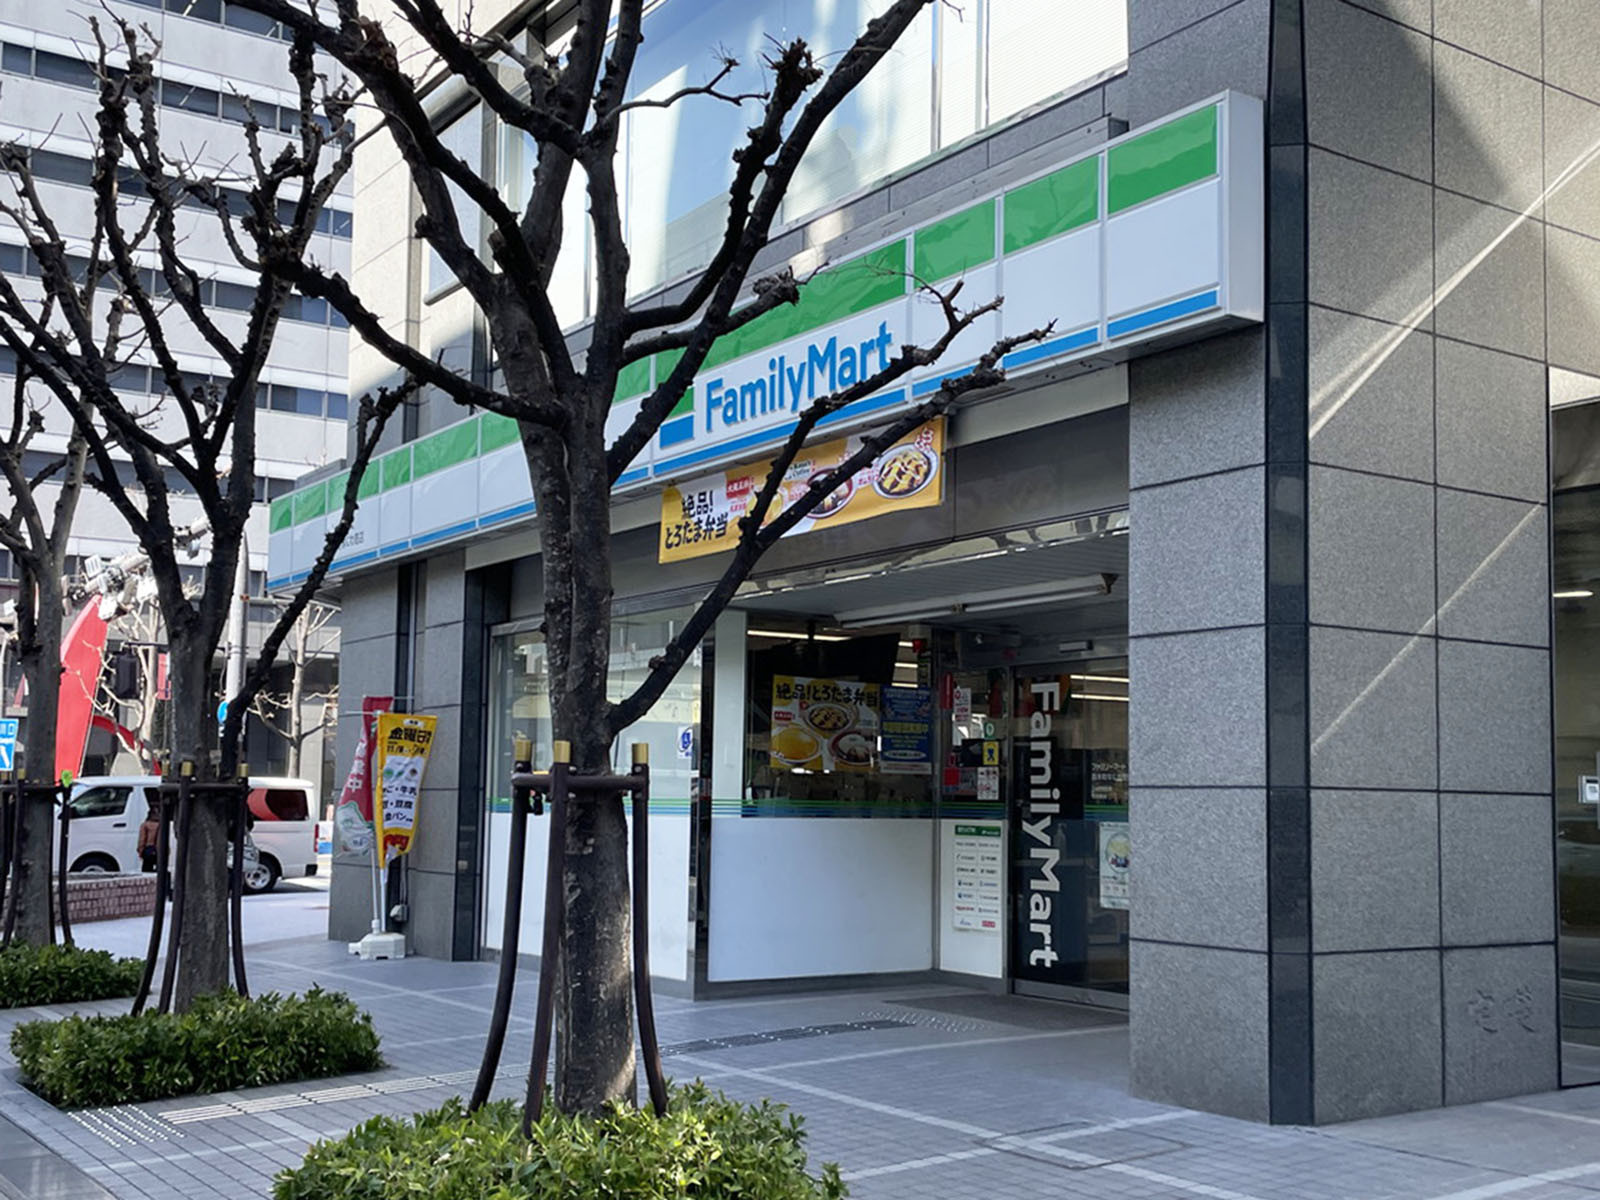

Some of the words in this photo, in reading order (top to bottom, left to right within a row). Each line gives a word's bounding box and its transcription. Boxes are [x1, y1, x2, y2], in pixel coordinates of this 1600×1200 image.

[706, 320, 893, 433] FamilyMart
[681, 490, 714, 519] 絶品!
[665, 512, 729, 550] とろたま弁当
[775, 682, 878, 707] 絶品!とろたま弁当
[1022, 682, 1060, 969] FamilyMart
